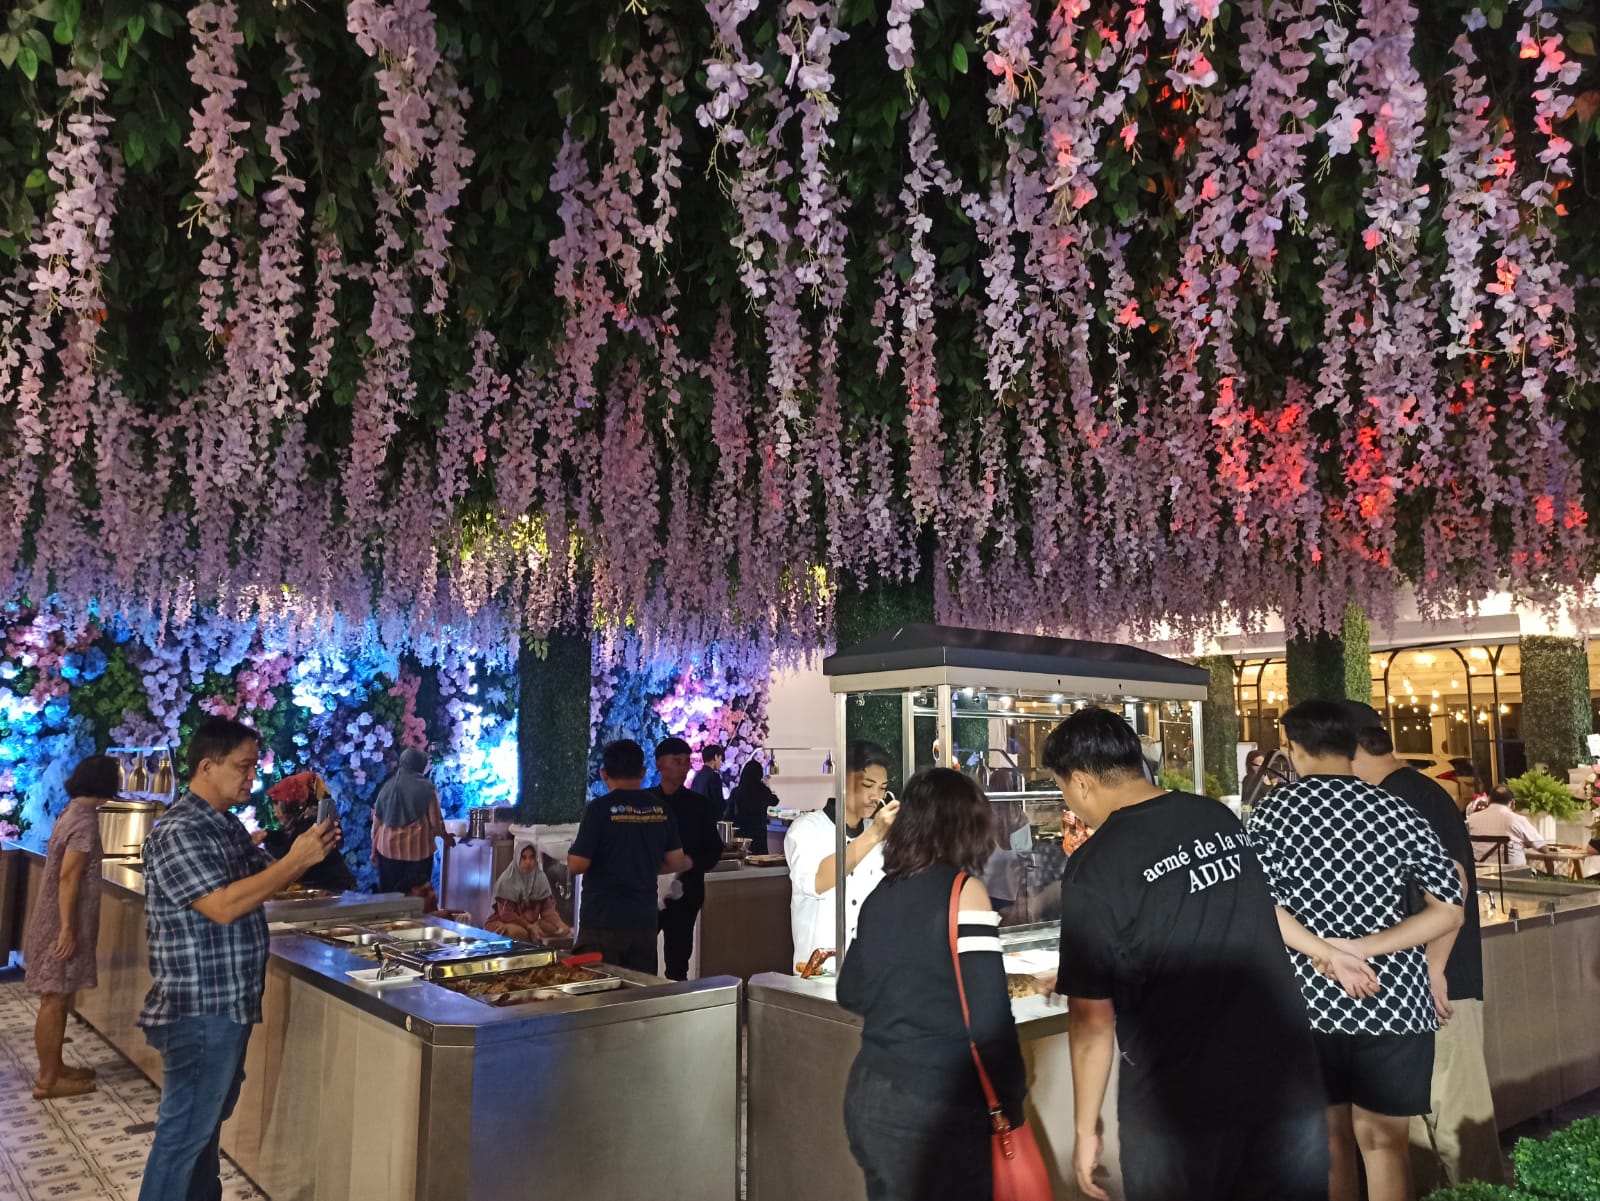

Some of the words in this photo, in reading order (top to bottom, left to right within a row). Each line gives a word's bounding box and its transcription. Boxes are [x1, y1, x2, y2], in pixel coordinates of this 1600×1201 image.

[1143, 844, 1191, 882] acmé
[1193, 838, 1217, 859] de
[1214, 832, 1237, 852] la
